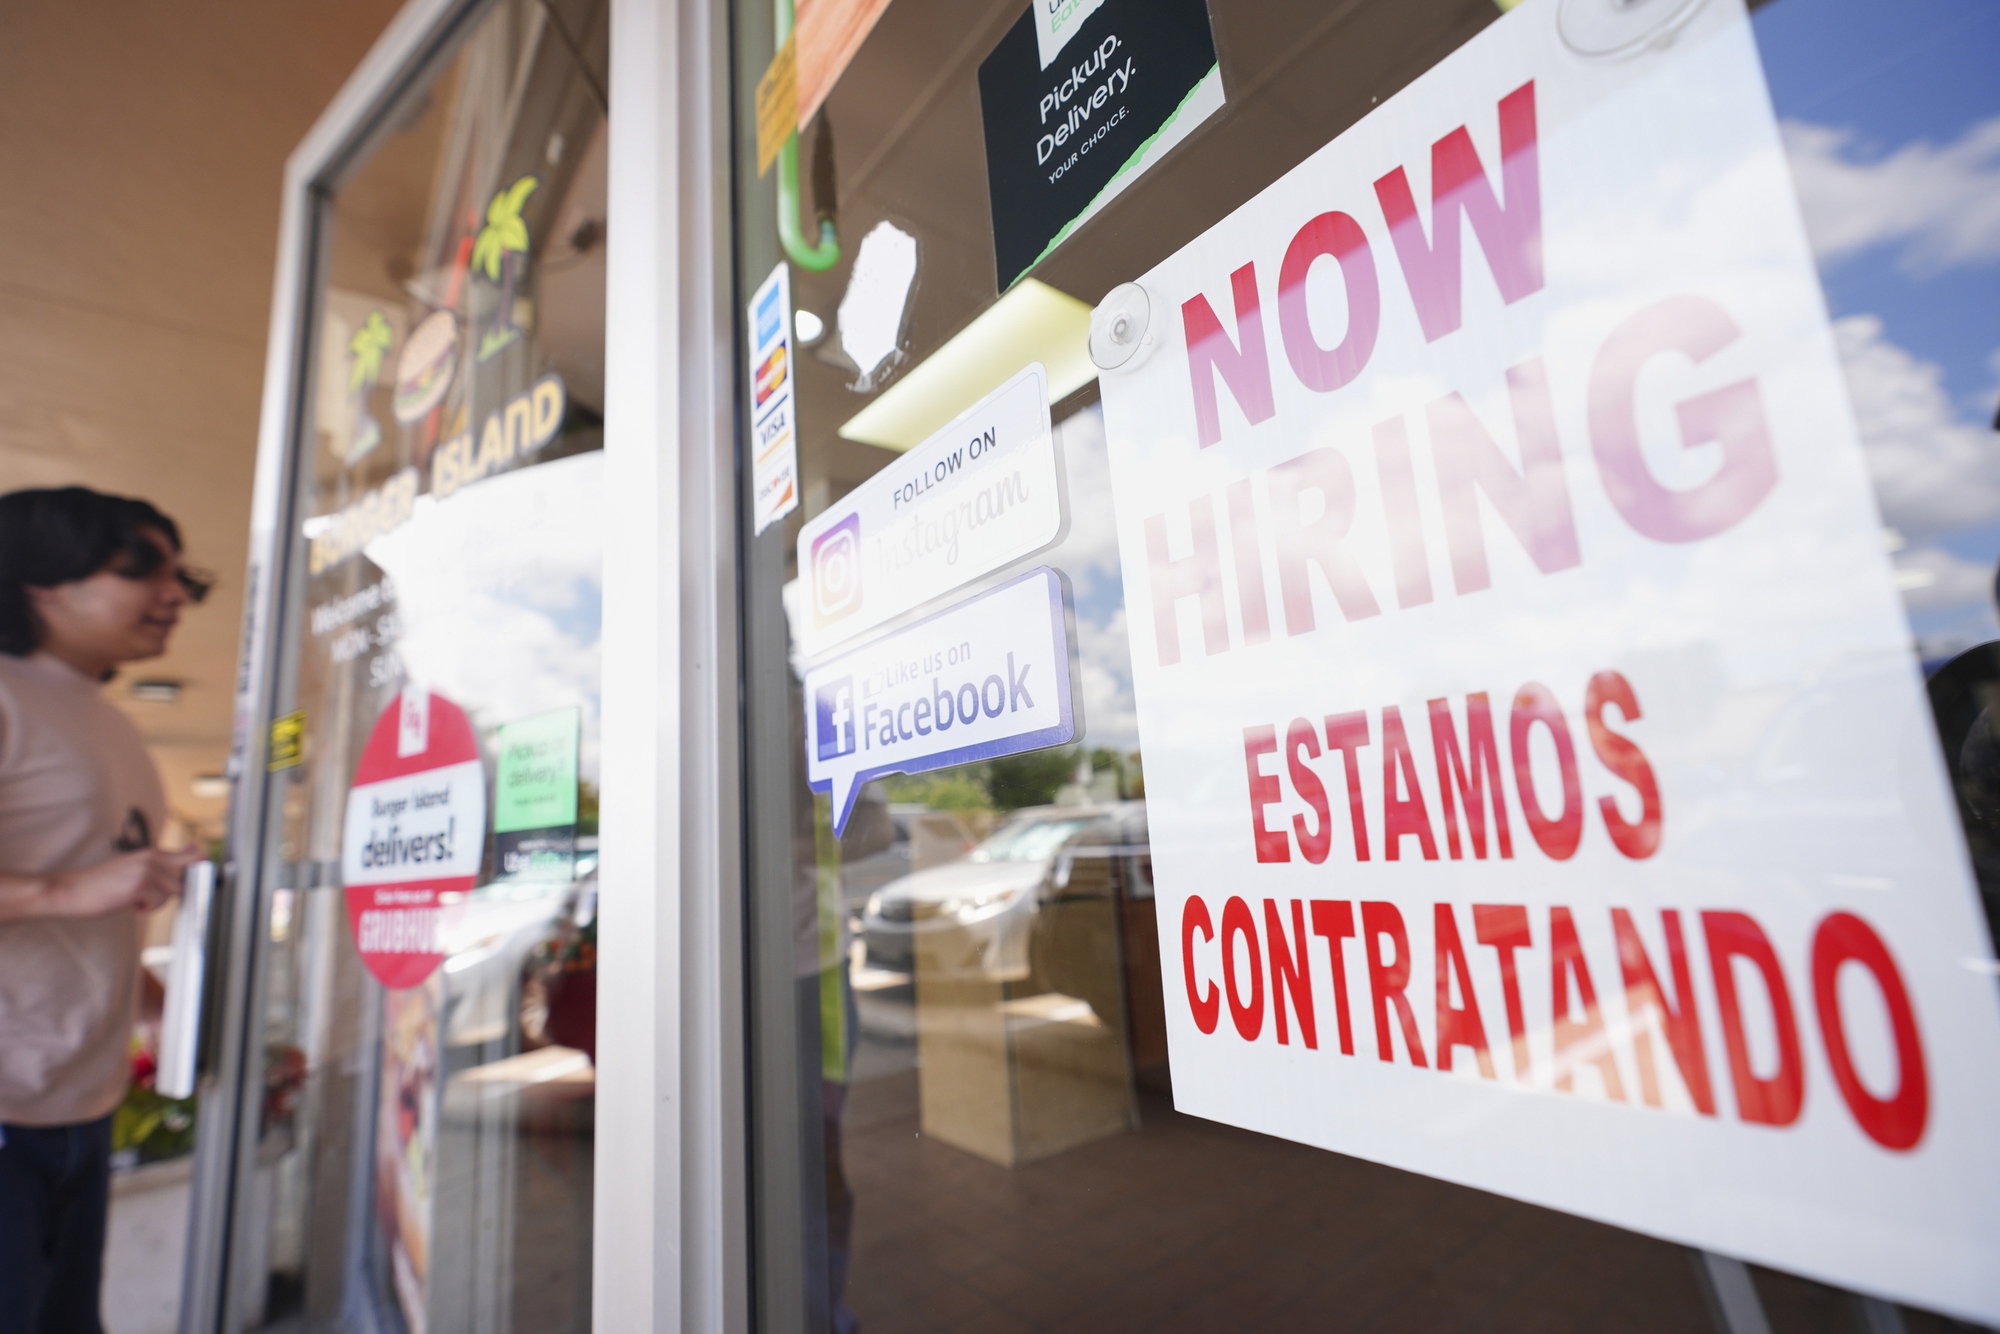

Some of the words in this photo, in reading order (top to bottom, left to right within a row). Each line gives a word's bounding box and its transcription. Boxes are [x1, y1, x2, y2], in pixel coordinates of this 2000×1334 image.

[1051, 0, 1085, 34] Eat
[1036, 56, 1136, 166] Delivery.
[1039, 34, 1122, 125] Pickup.
[1048, 152, 1079, 184] YOUR
[1080, 106, 1130, 155] CHOICE.
[1181, 78, 1545, 450] NOW
[432, 379, 564, 500] ISLAND
[760, 412, 786, 445] VISA
[893, 448, 963, 510] FOLLOW
[969, 426, 997, 460] ON
[873, 470, 1030, 583] Instagram
[1143, 293, 1782, 667] HIRING
[864, 651, 1036, 750] Facebook
[885, 663, 918, 688] Like
[923, 653, 943, 675] us
[947, 641, 971, 667] on
[1243, 669, 1665, 865] ESTAMOS
[361, 815, 457, 869] delivers!
[1181, 894, 1934, 1154] CONTRATANDO
